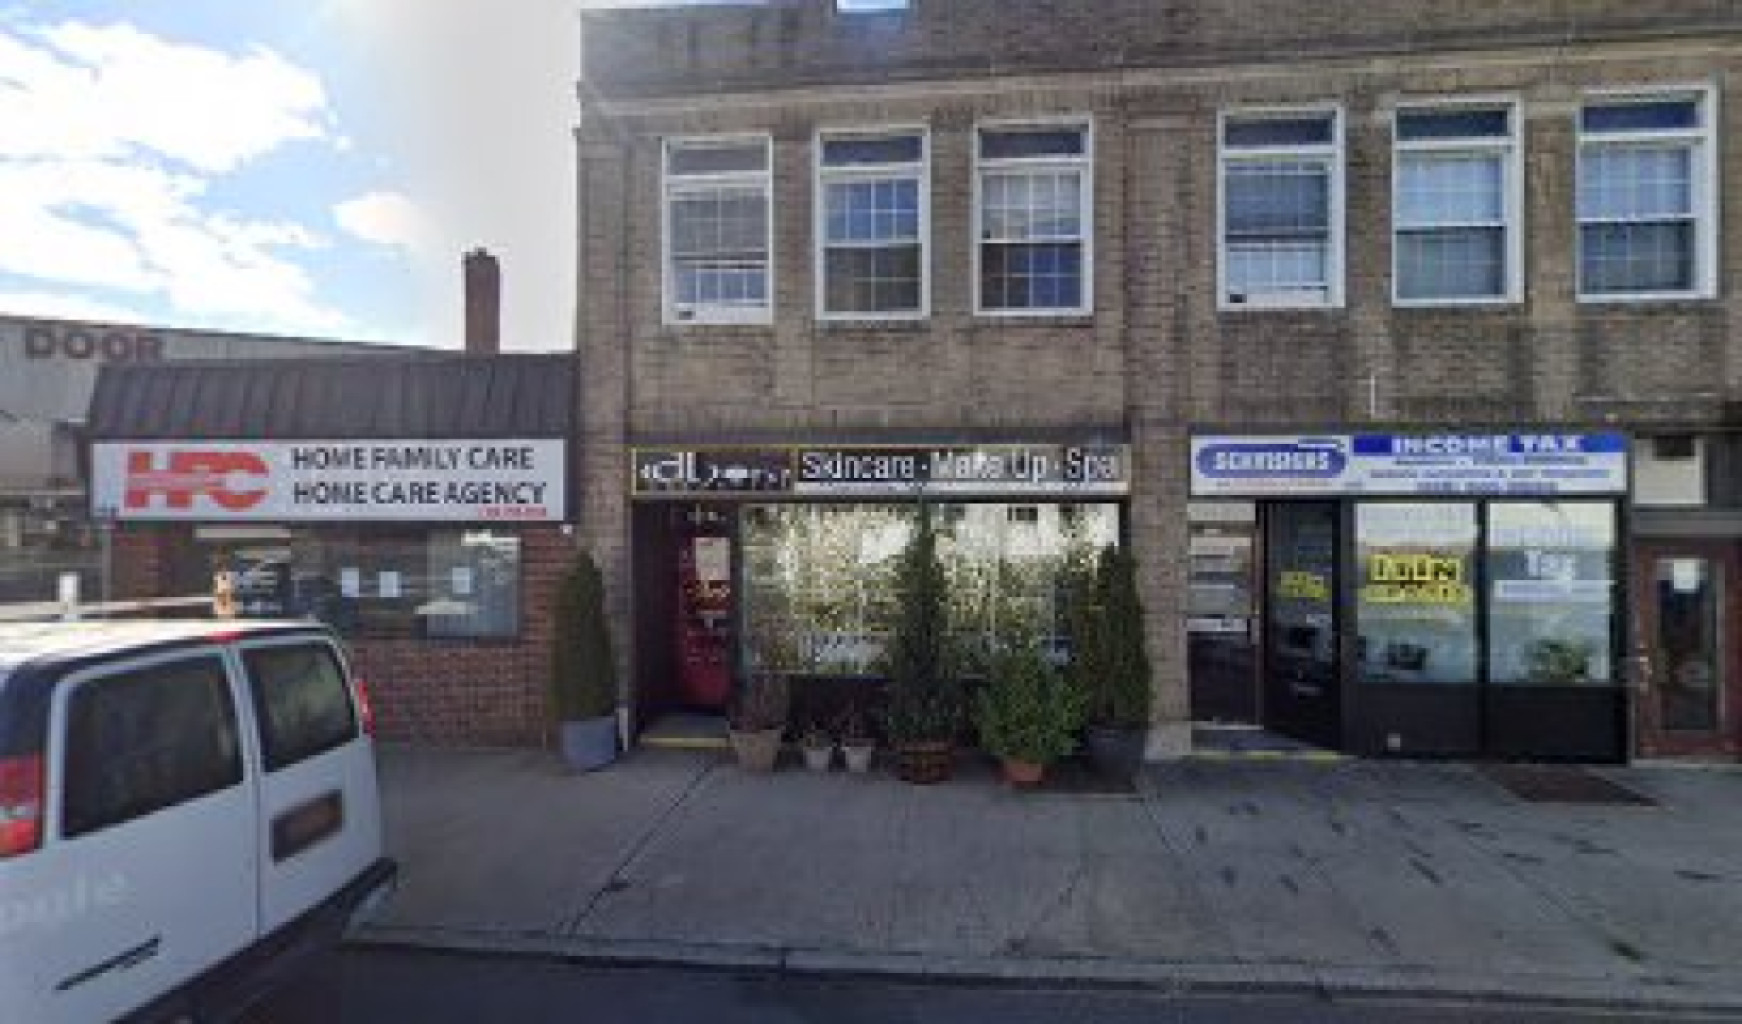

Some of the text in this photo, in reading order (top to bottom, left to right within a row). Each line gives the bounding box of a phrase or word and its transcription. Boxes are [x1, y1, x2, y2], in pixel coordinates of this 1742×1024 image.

[1392, 435, 1584, 455] INCOME TAX
[291, 447, 535, 470] HOME FAMILY CARE
[801, 449, 915, 480] Skincare
[1012, 447, 1049, 484] Up
[1065, 445, 1118, 484] Spa
[293, 481, 547, 505] HOME CARE AGENCY
